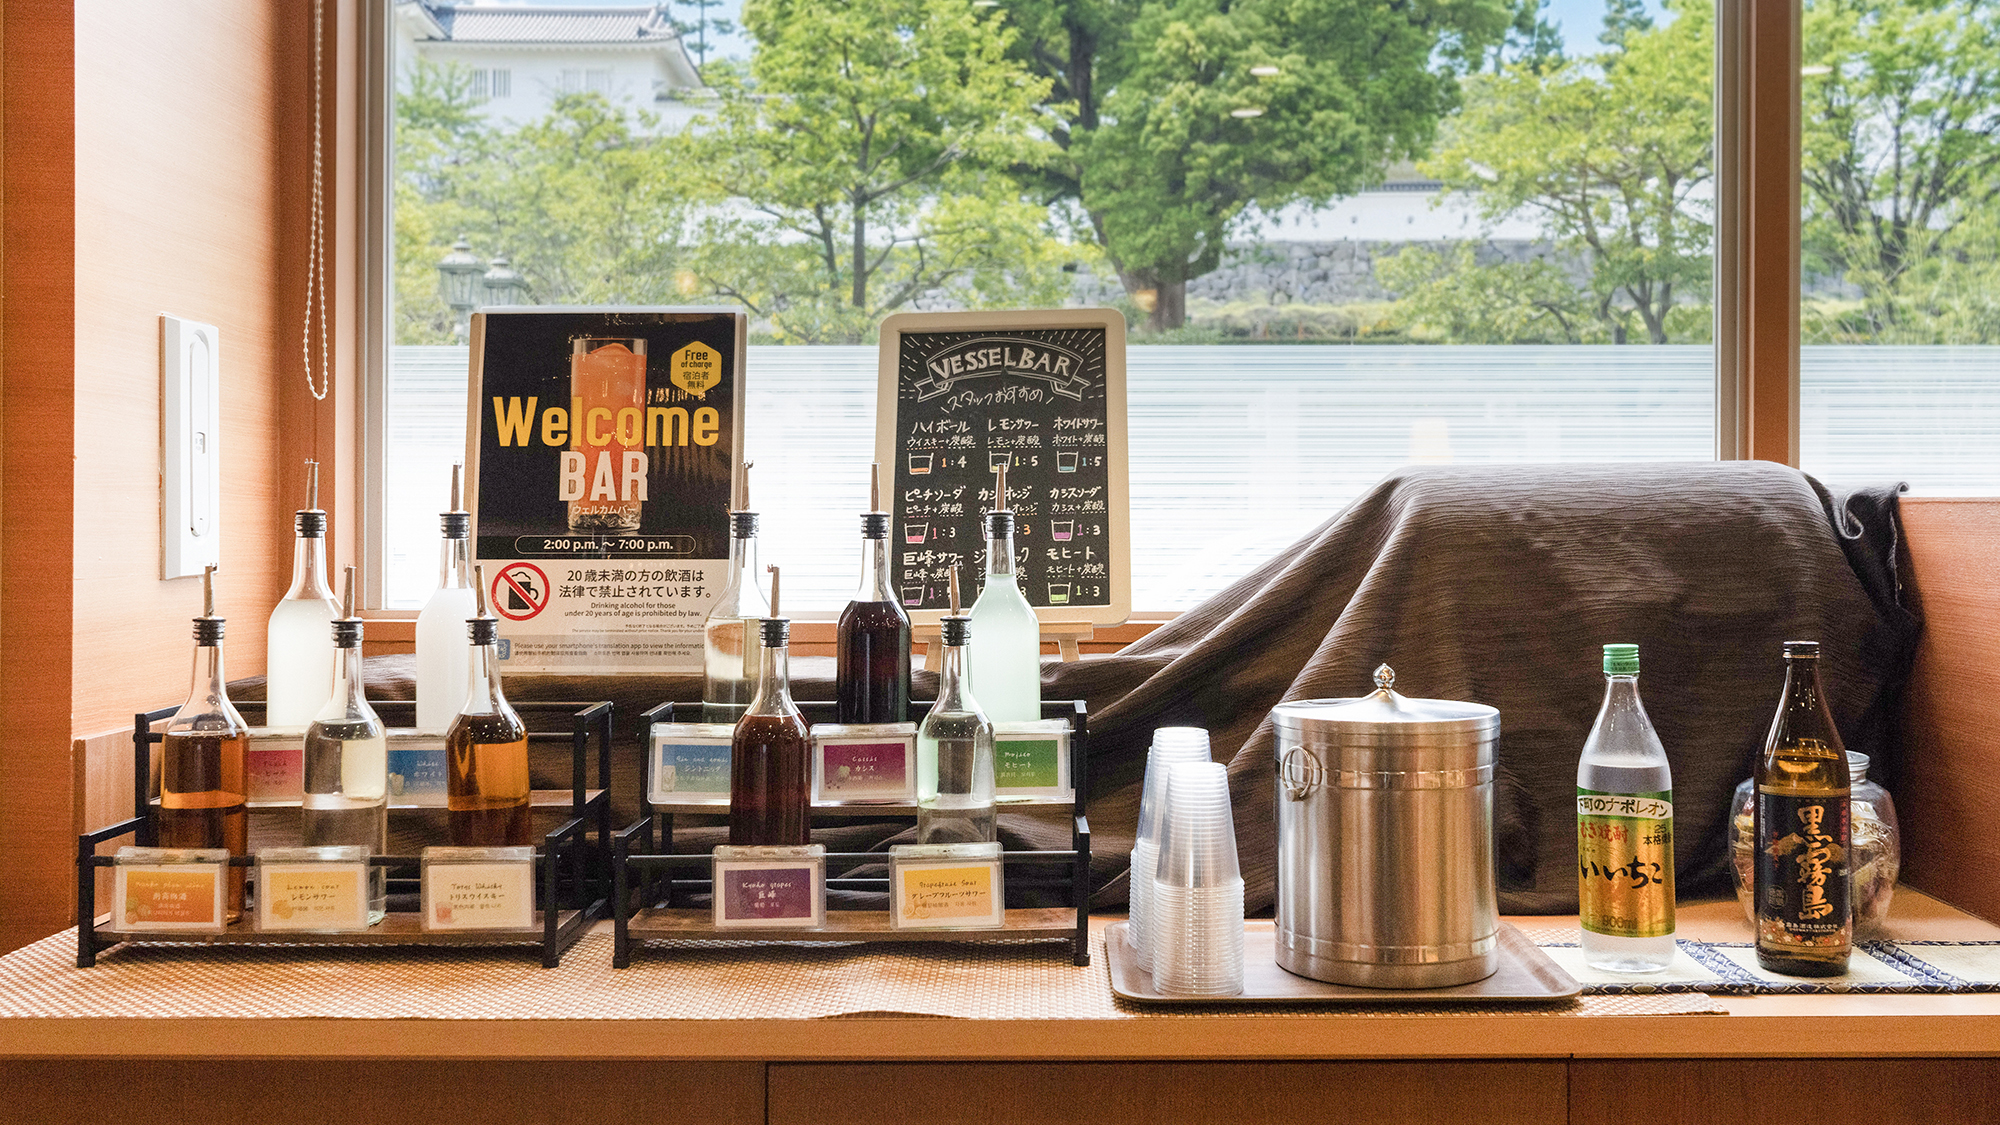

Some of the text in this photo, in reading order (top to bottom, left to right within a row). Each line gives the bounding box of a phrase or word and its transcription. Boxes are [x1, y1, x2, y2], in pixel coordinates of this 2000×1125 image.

[685, 349, 708, 360] Free
[688, 361, 713, 370] charge
[683, 371, 710, 380] 宿泊者
[687, 380, 705, 389] 無料
[492, 396, 720, 447] Welcome
[911, 419, 971, 434] ハイボール
[988, 418, 1039, 432] レモンサワー
[1053, 416, 1104, 431] ホワイトサワー
[559, 450, 649, 502] BAR
[905, 485, 967, 502] ピーチソーダ
[977, 485, 1033, 502] カシオレンジ
[1049, 486, 1102, 500] カシスソーダ
[572, 504, 636, 515] ウェルカムバー
[543, 540, 571, 550] 2:00
[573, 541, 599, 552] p.m.
[619, 540, 645, 550] 7:00
[647, 541, 674, 552] p.m.
[1046, 546, 1096, 560] モヒート
[903, 549, 964, 567] 巨峰サワー
[558, 585, 712, 599] 法律で禁止されています。
[591, 602, 676, 611] Drinking alcohol for those
[564, 610, 702, 619] under 20 years of age is prohibited by law.
[545, 642, 558, 650] your
[631, 642, 642, 651] app
[1004, 761, 1031, 769] モヒート
[1578, 797, 1668, 817] 下町のナポレオン
[1580, 821, 1628, 844] むぎ焼酎
[1796, 804, 1834, 920] 黒霧島
[1580, 854, 1664, 889] いいちこ
[291, 893, 336, 901] レモンサワー
[450, 893, 505, 901] トリスウイスキー
[758, 890, 777, 899] 巨峰
[911, 890, 986, 900] グレープフルーツサワー
